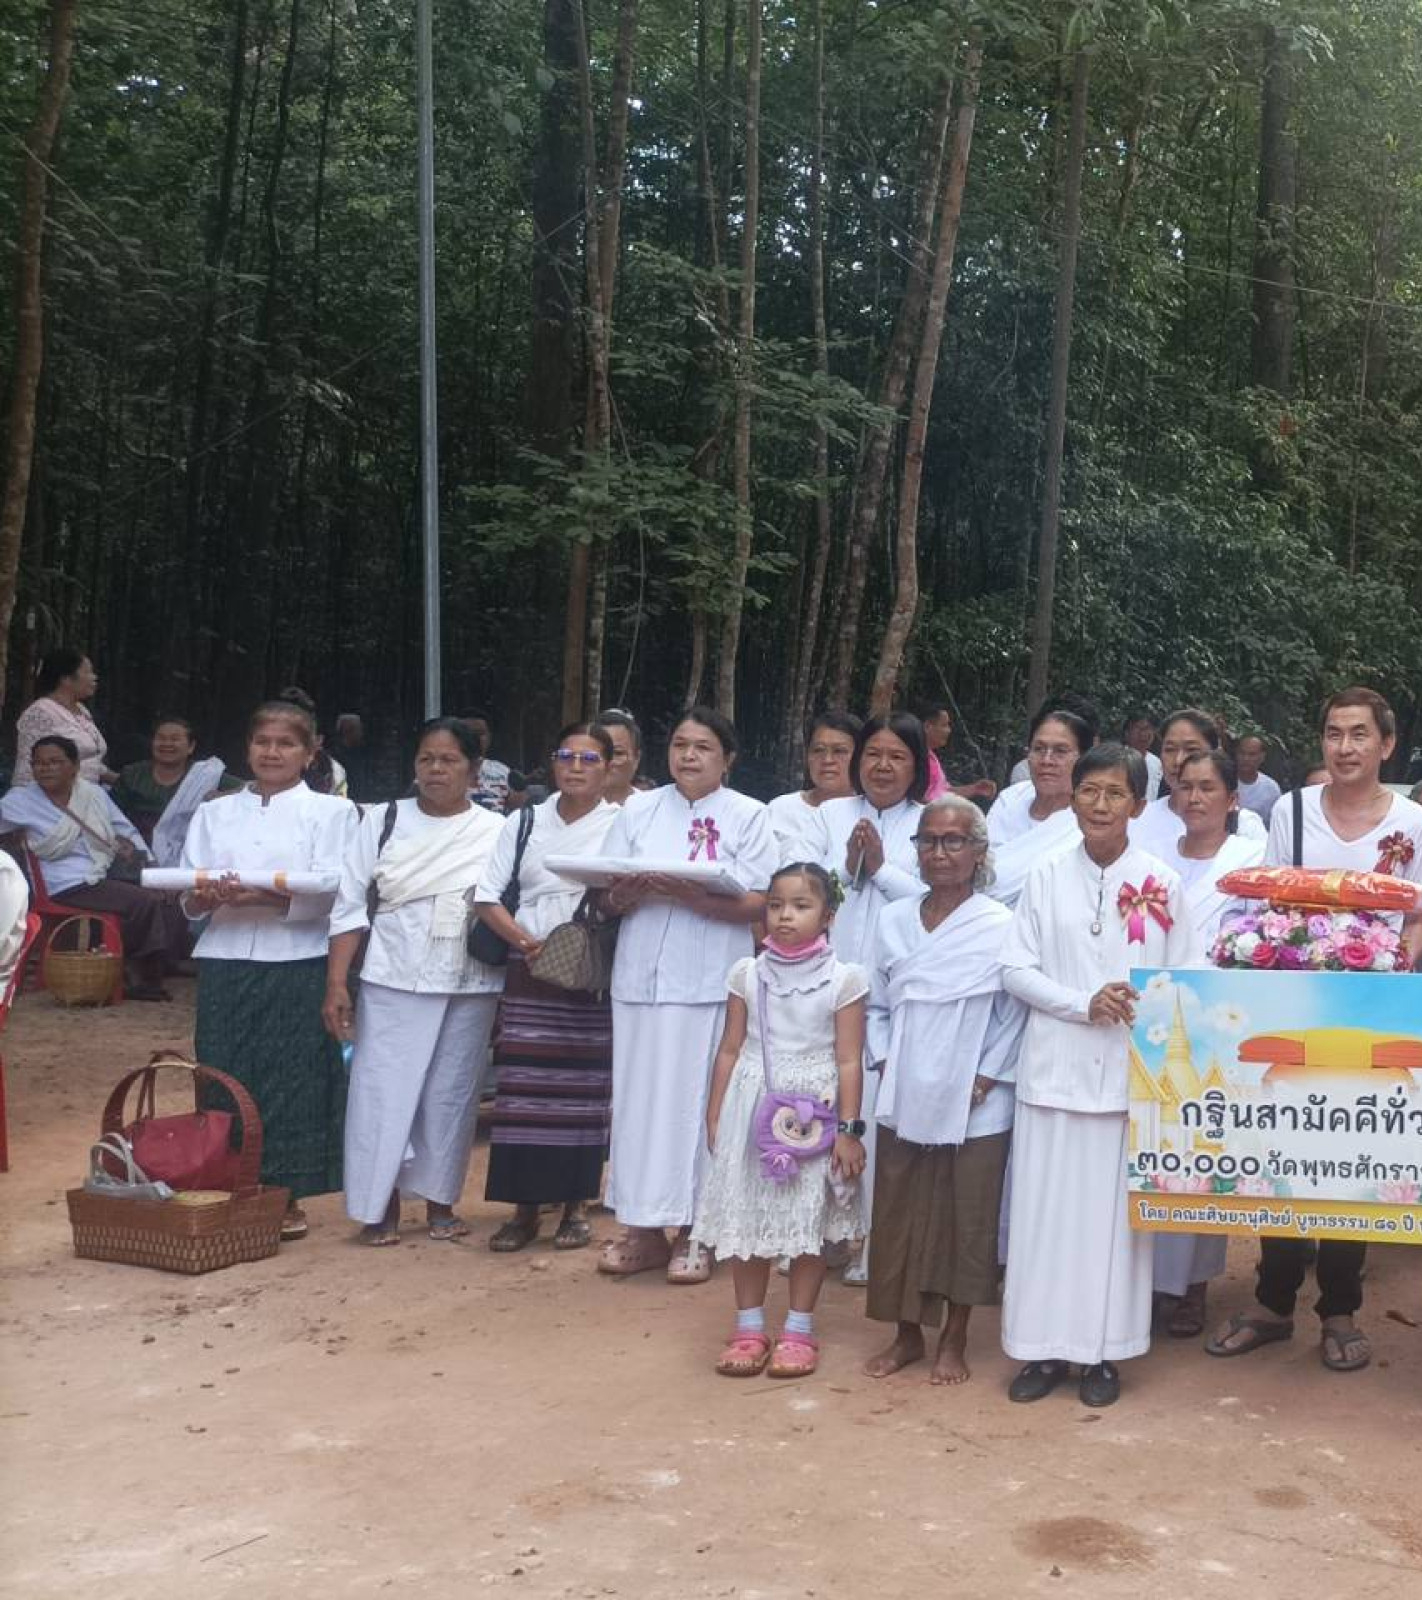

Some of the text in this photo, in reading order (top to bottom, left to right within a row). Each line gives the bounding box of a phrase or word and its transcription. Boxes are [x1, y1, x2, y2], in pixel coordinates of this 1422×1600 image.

[1137, 1151, 1261, 1177] ๓๐,๐๐๐
[1139, 1202, 1167, 1219] โดย
[1402, 1214, 1415, 1231] ปี
